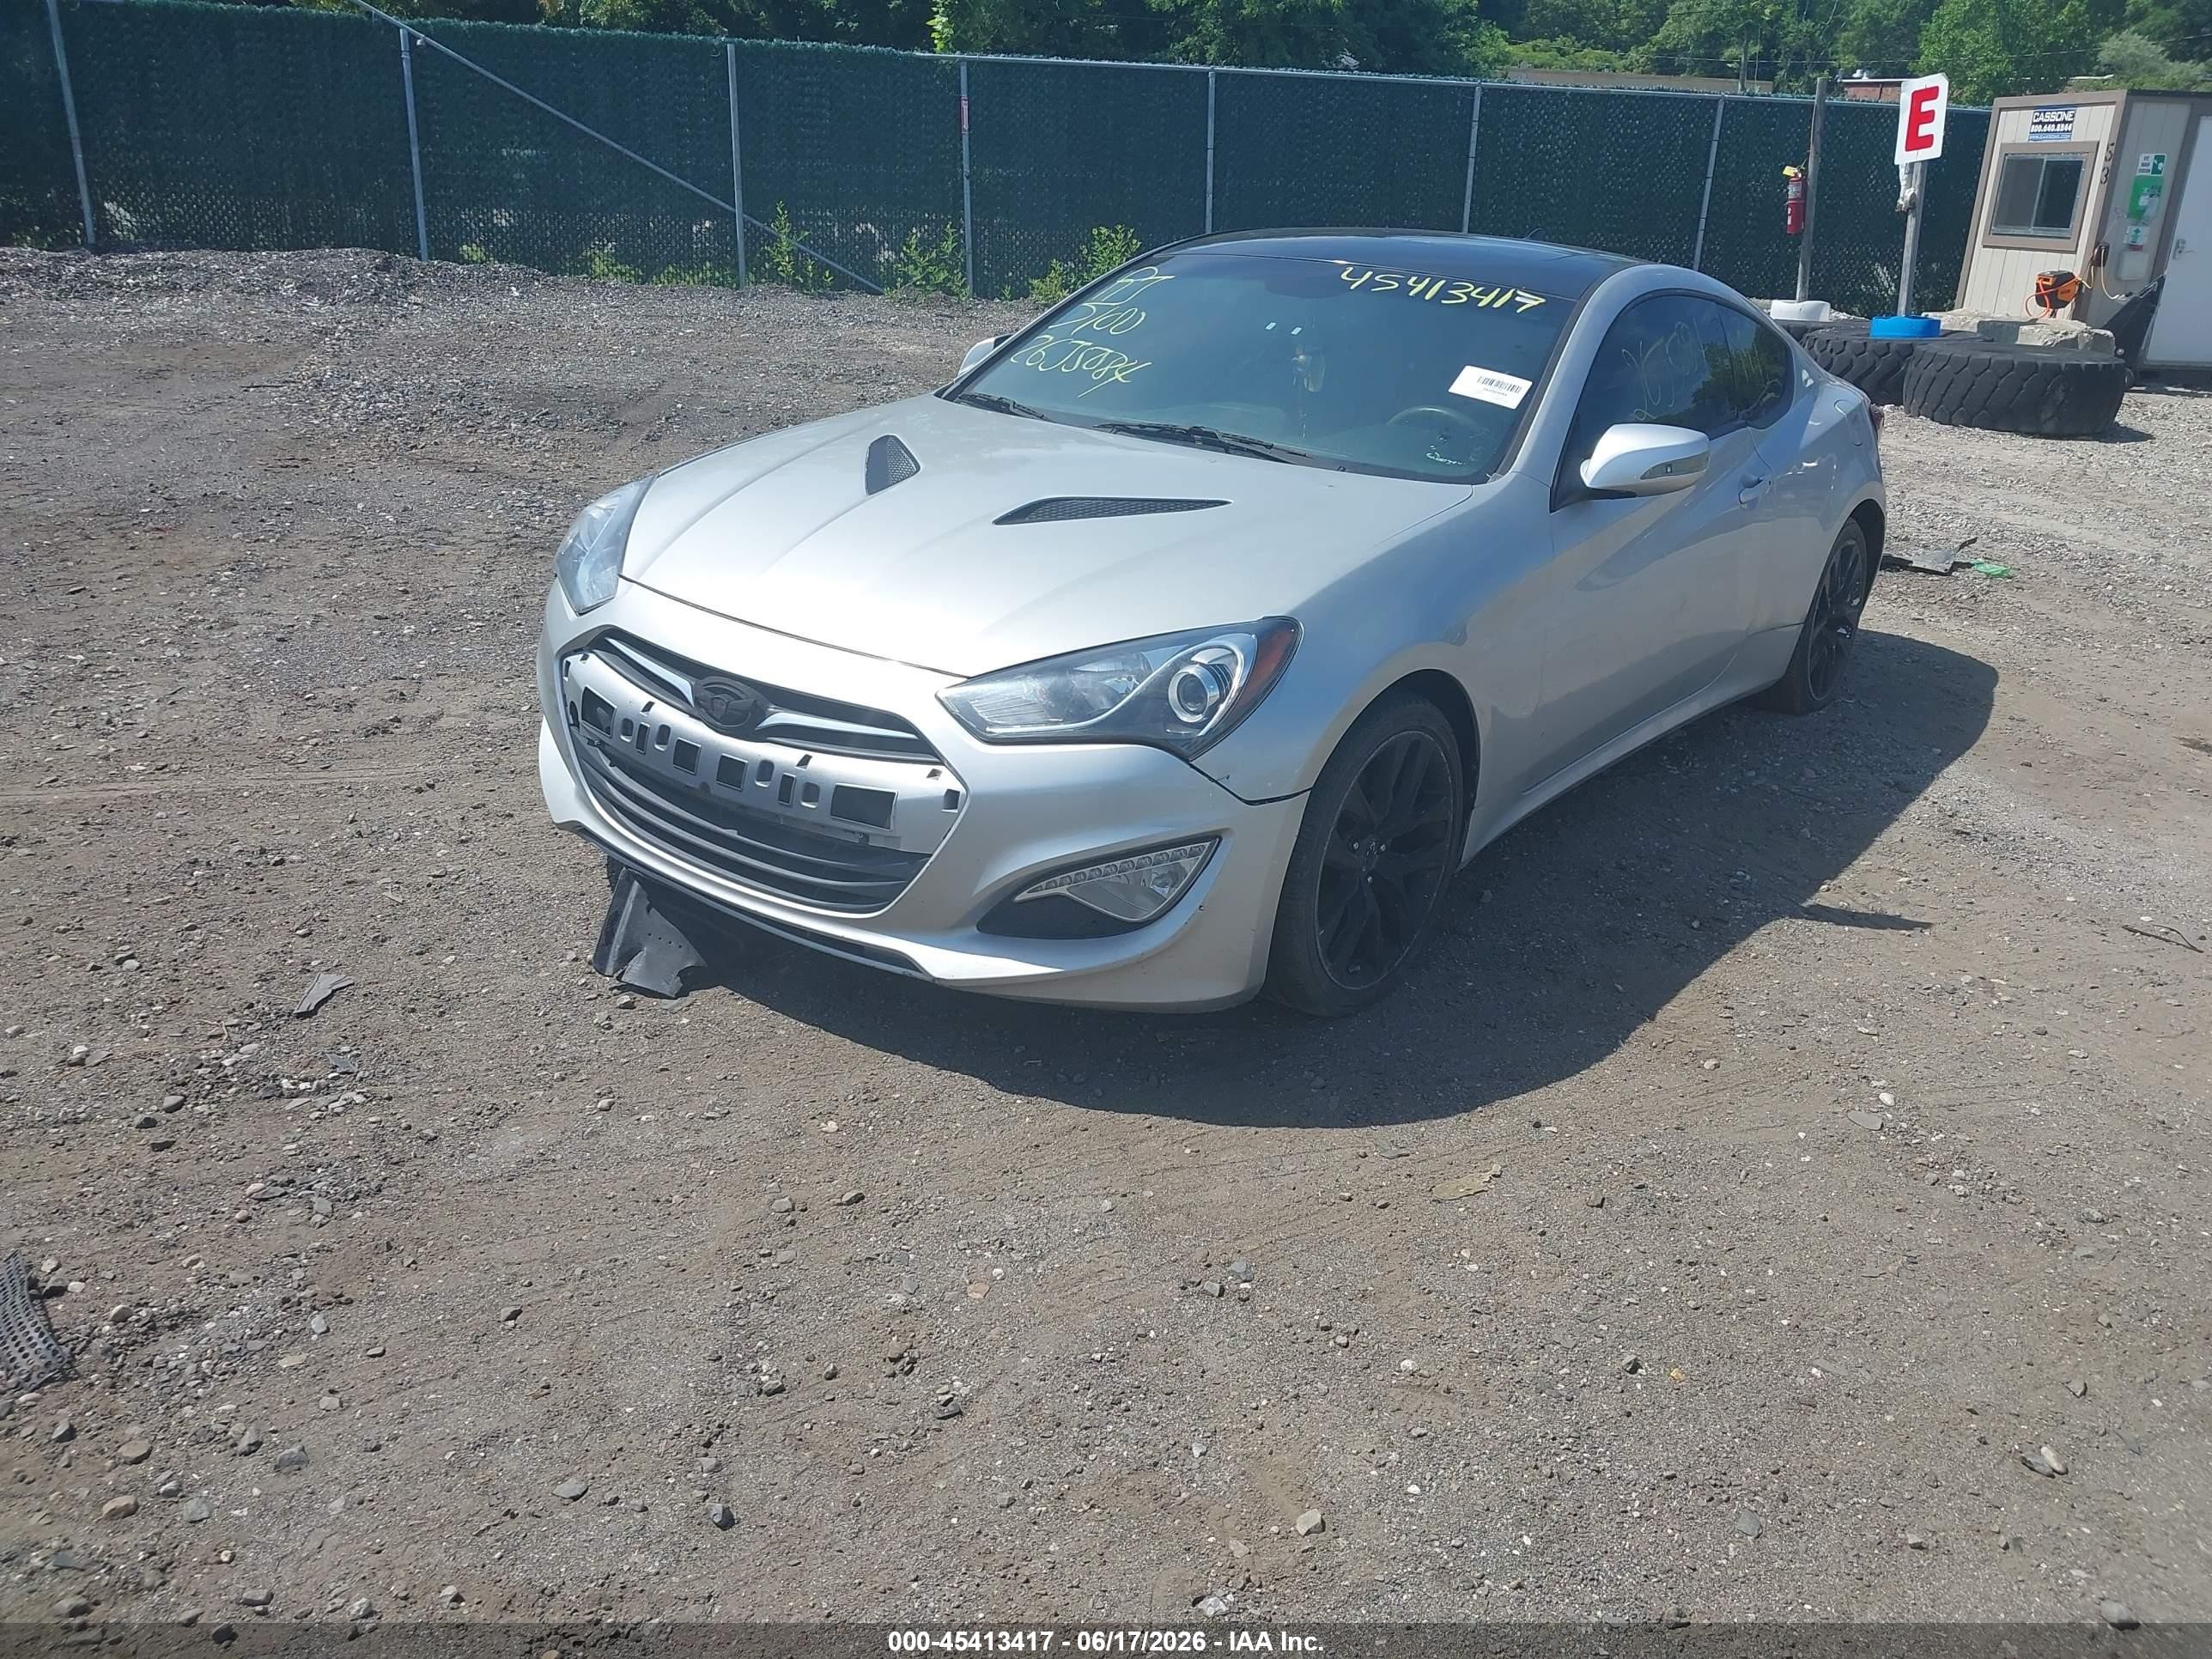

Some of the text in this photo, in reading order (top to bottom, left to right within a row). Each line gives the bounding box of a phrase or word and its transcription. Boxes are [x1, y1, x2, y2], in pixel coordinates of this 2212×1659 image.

[1905, 86, 1939, 152] E
[2033, 111, 2075, 123] CASSONE
[1340, 266, 1547, 313] 45413417
